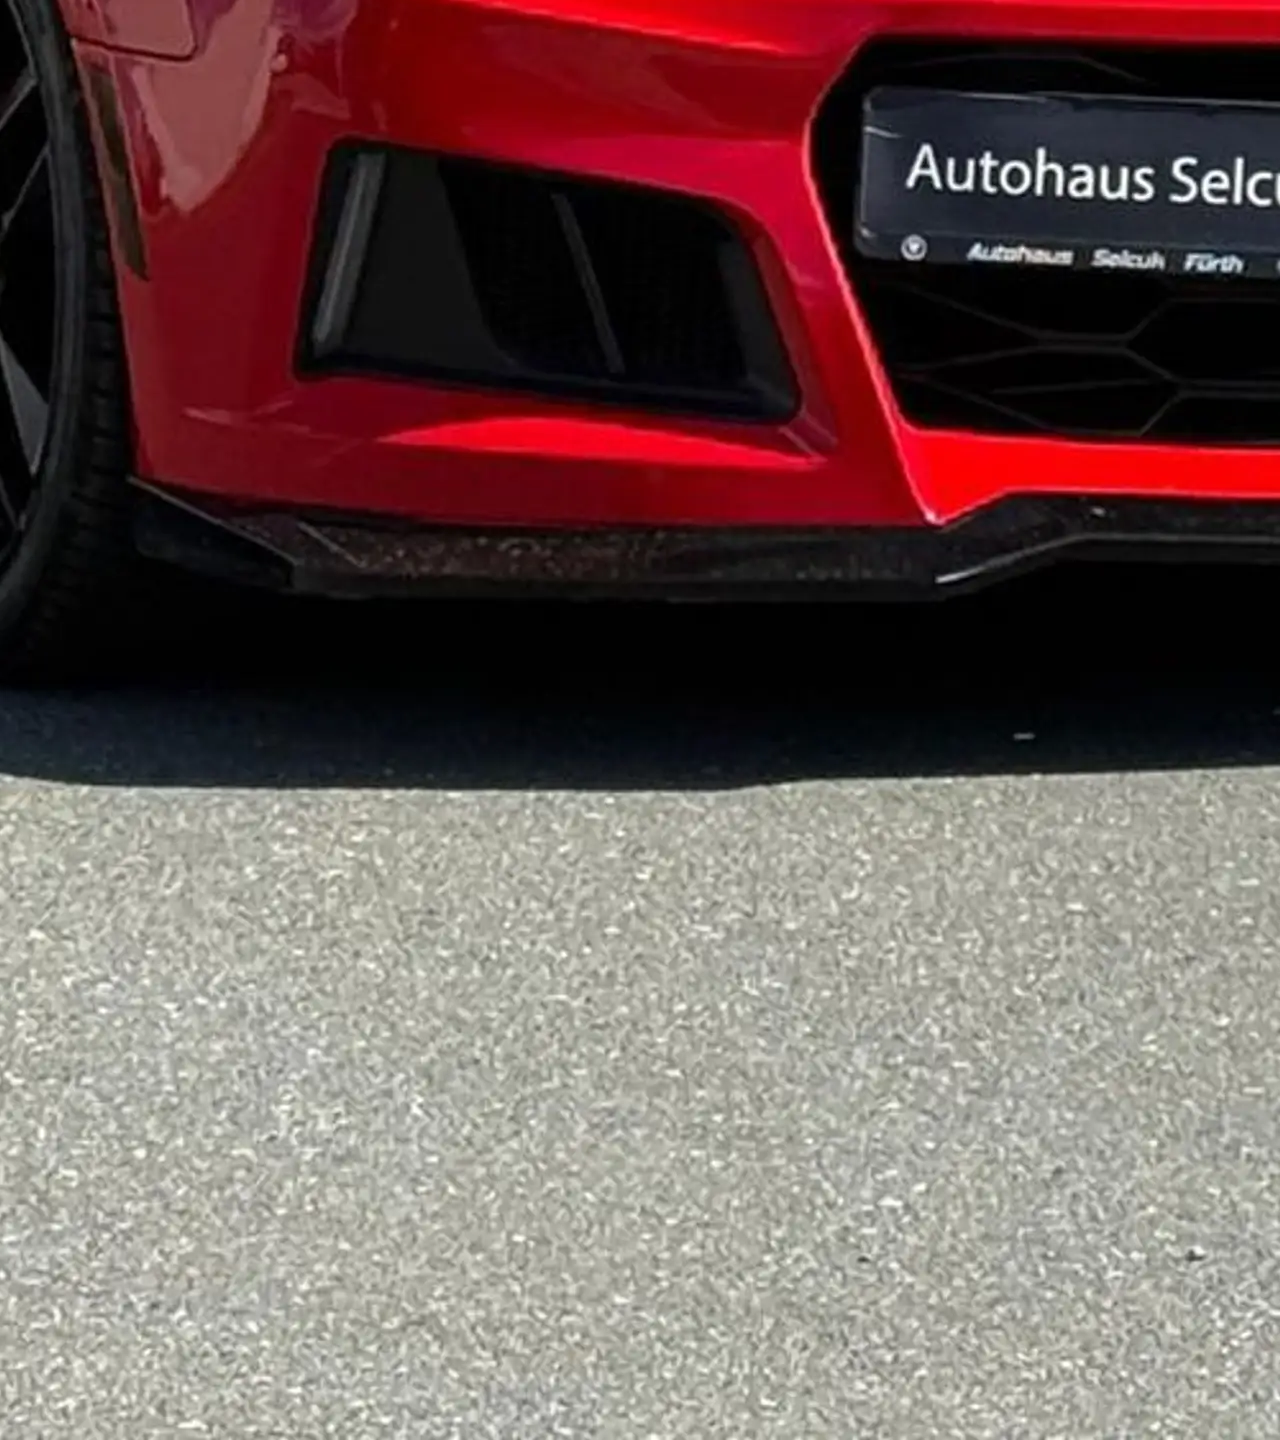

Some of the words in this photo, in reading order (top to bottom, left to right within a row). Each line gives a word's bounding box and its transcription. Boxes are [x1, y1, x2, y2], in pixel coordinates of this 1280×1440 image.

[906, 143, 1157, 203] Autohaus
[966, 242, 1074, 266] Autohaus
[1089, 248, 1166, 270] Selcuk
